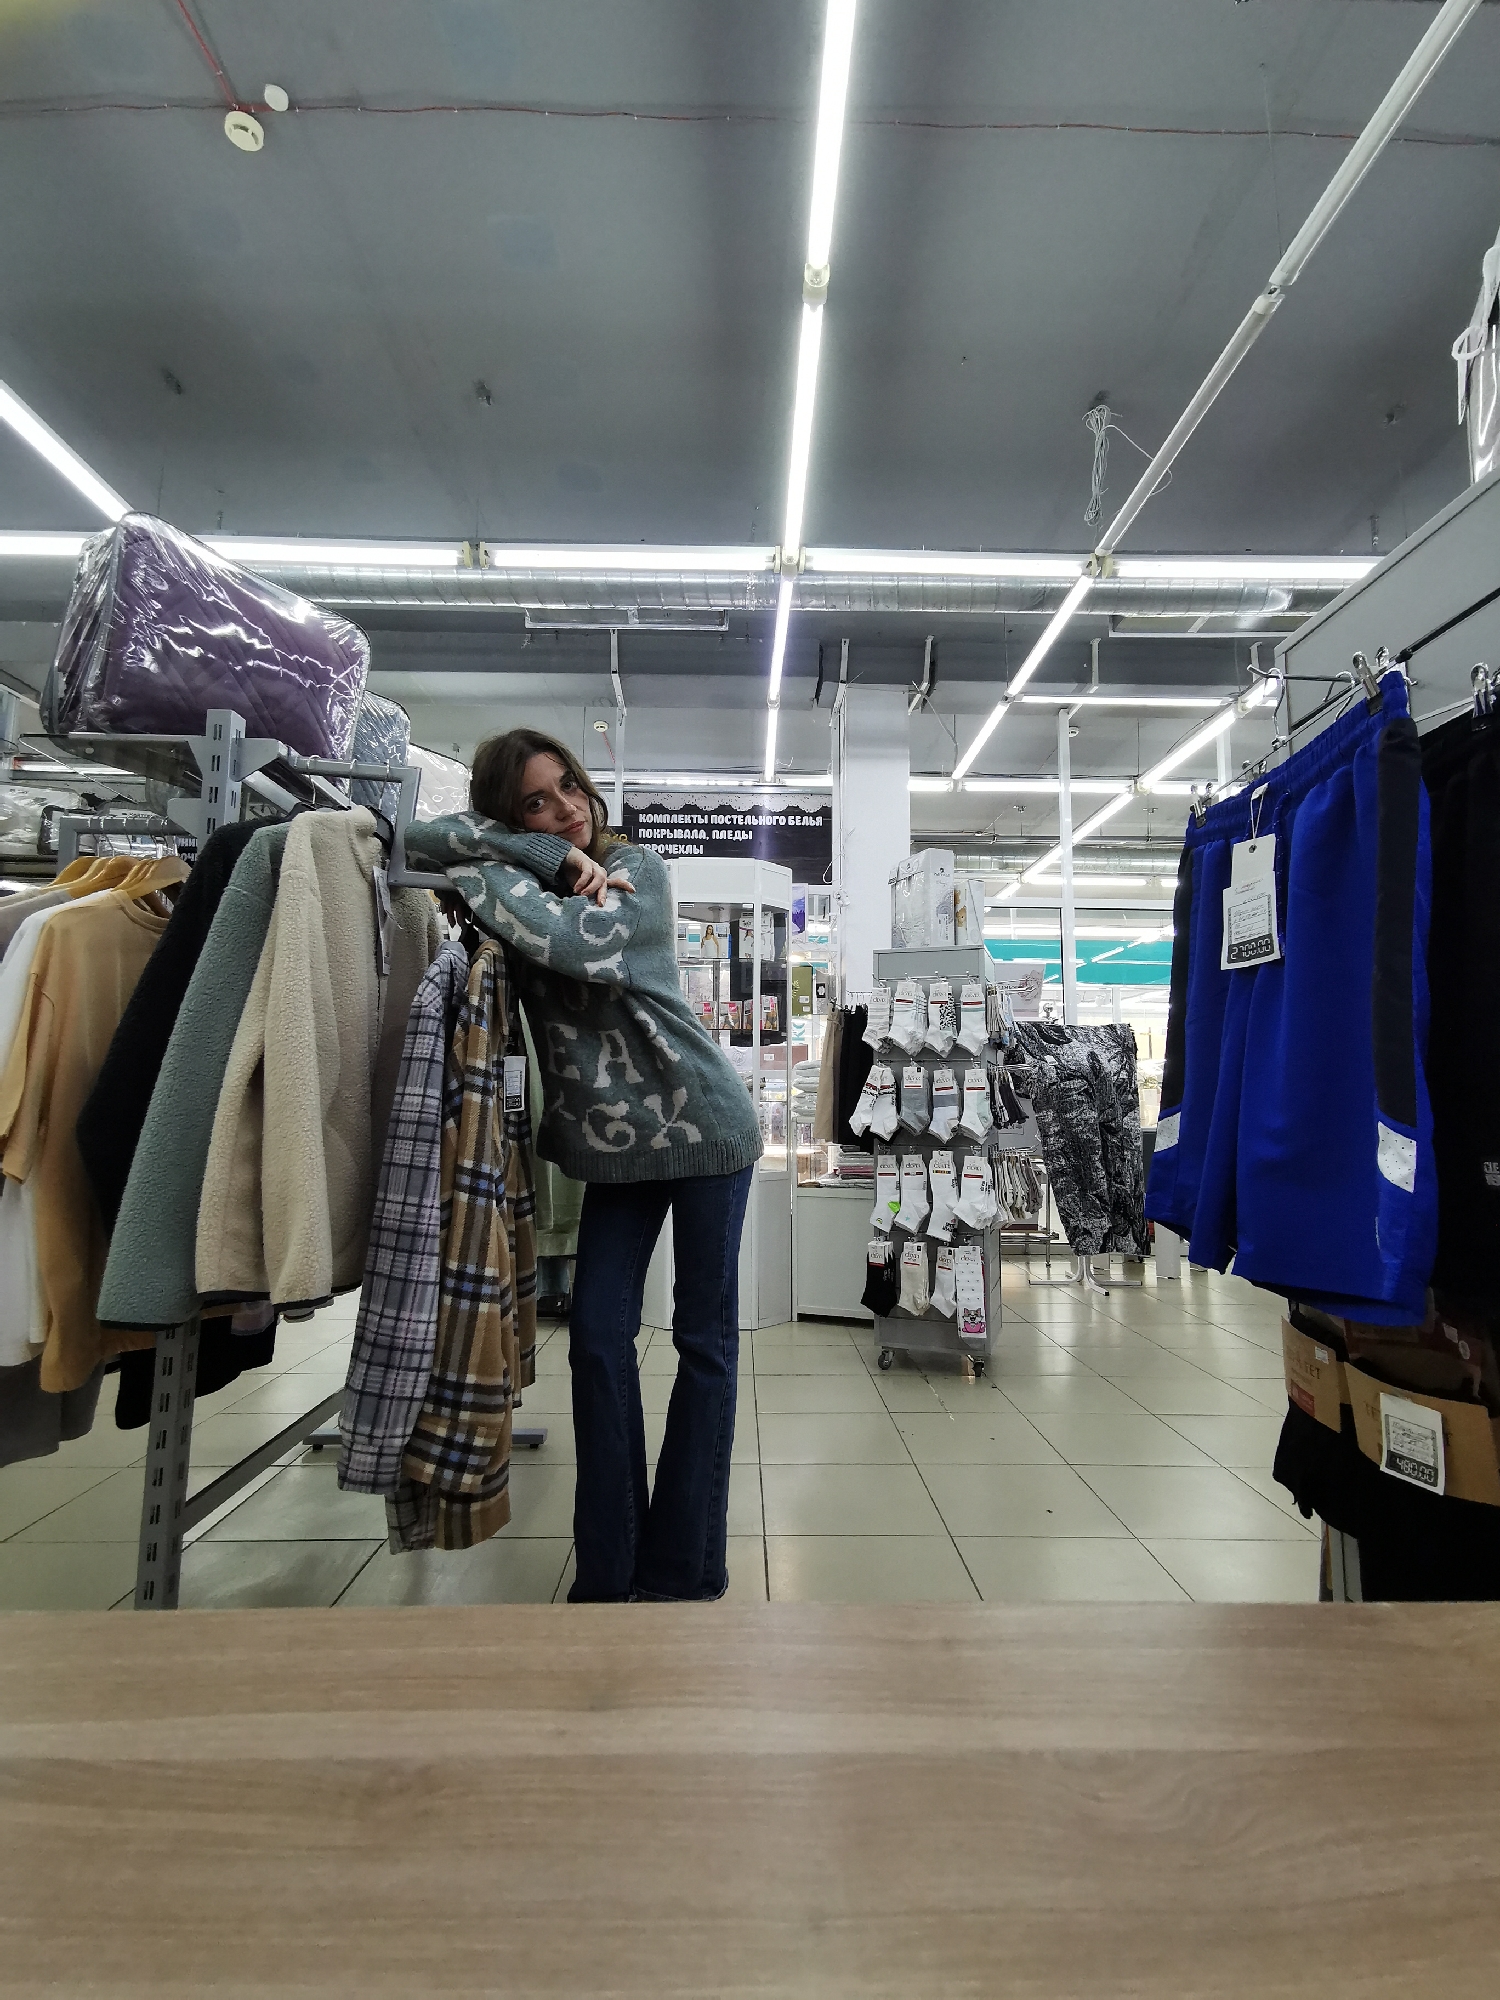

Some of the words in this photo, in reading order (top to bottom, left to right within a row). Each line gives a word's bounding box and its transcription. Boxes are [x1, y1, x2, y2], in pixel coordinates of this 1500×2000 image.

[638, 813, 708, 825] КОМПЛЕКТЫ
[710, 814, 786, 826] ПОСТЕЛЬНОГО
[788, 816, 823, 827] БЕЛЬЯ
[638, 828, 710, 841] ПОКРЫВАЛА,
[712, 829, 753, 842] ПЛЕДЫ
